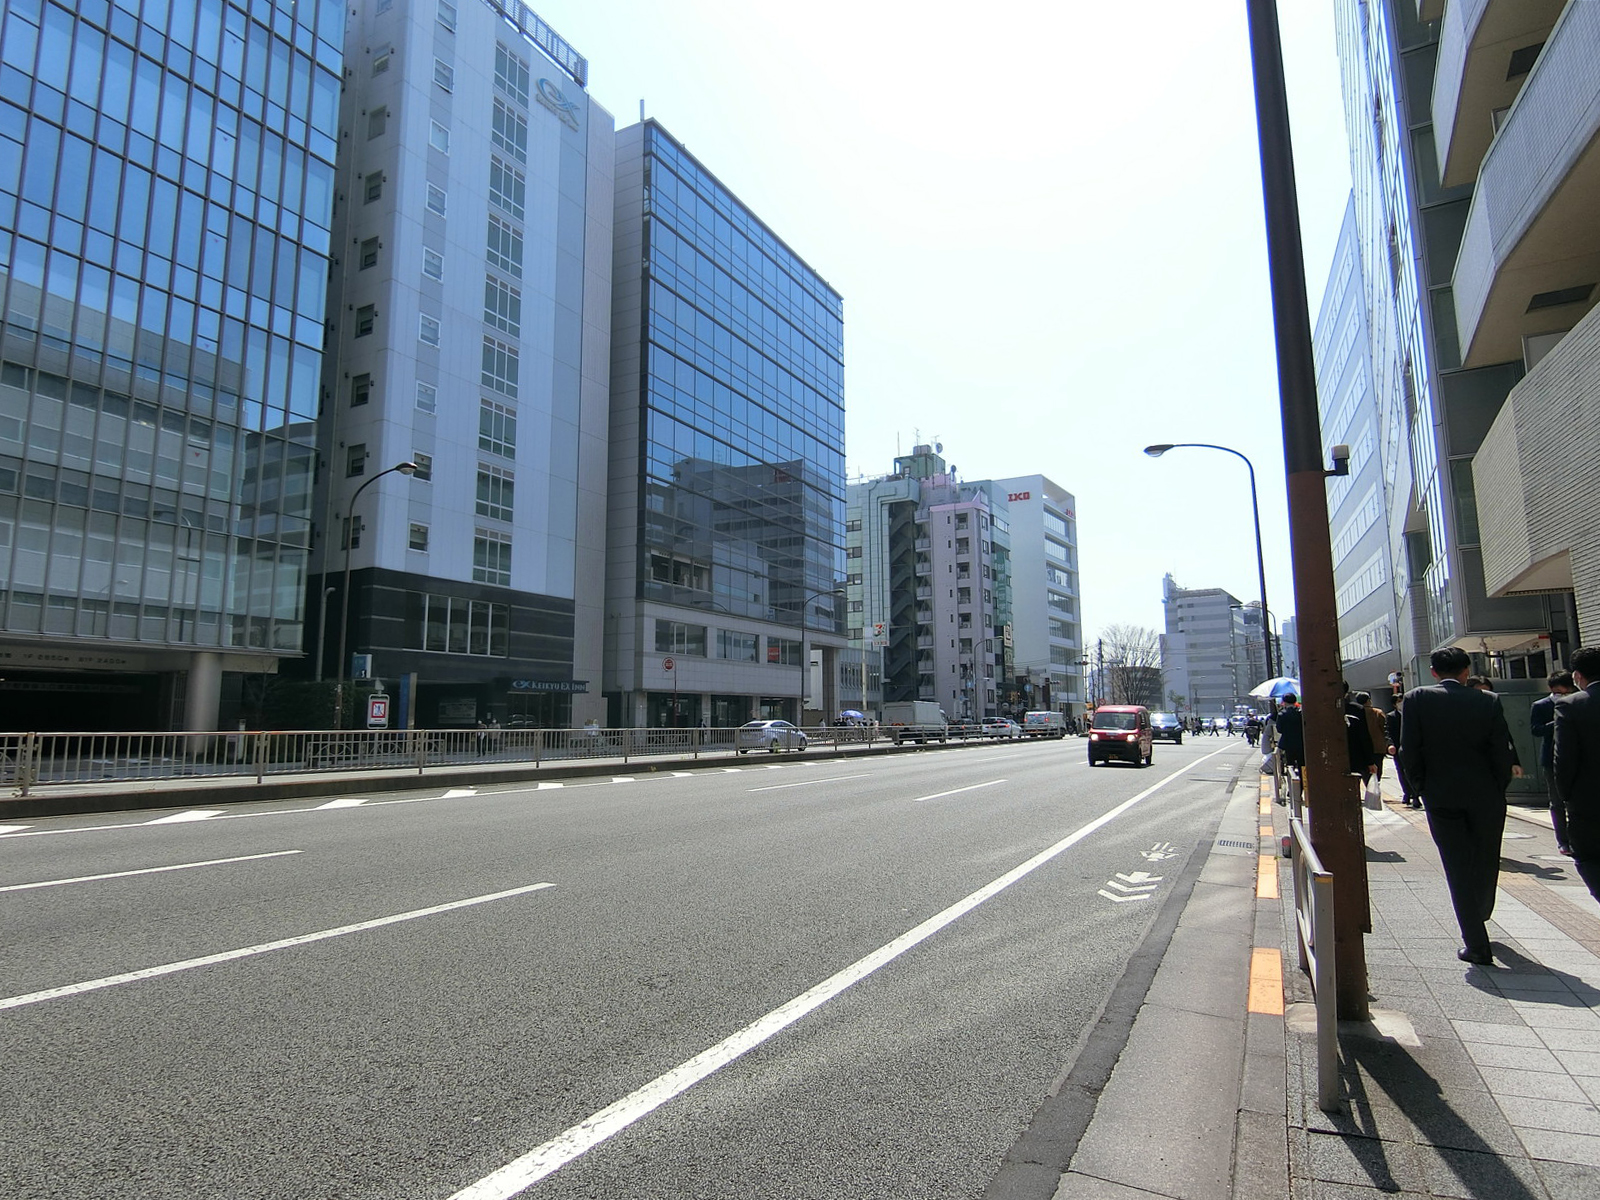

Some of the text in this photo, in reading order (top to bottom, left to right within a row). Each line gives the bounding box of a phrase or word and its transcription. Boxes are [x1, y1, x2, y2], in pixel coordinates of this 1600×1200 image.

[1007, 491, 1030, 502] IKO
[531, 681, 560, 690] KEIKYU
[572, 683, 586, 691] INN
